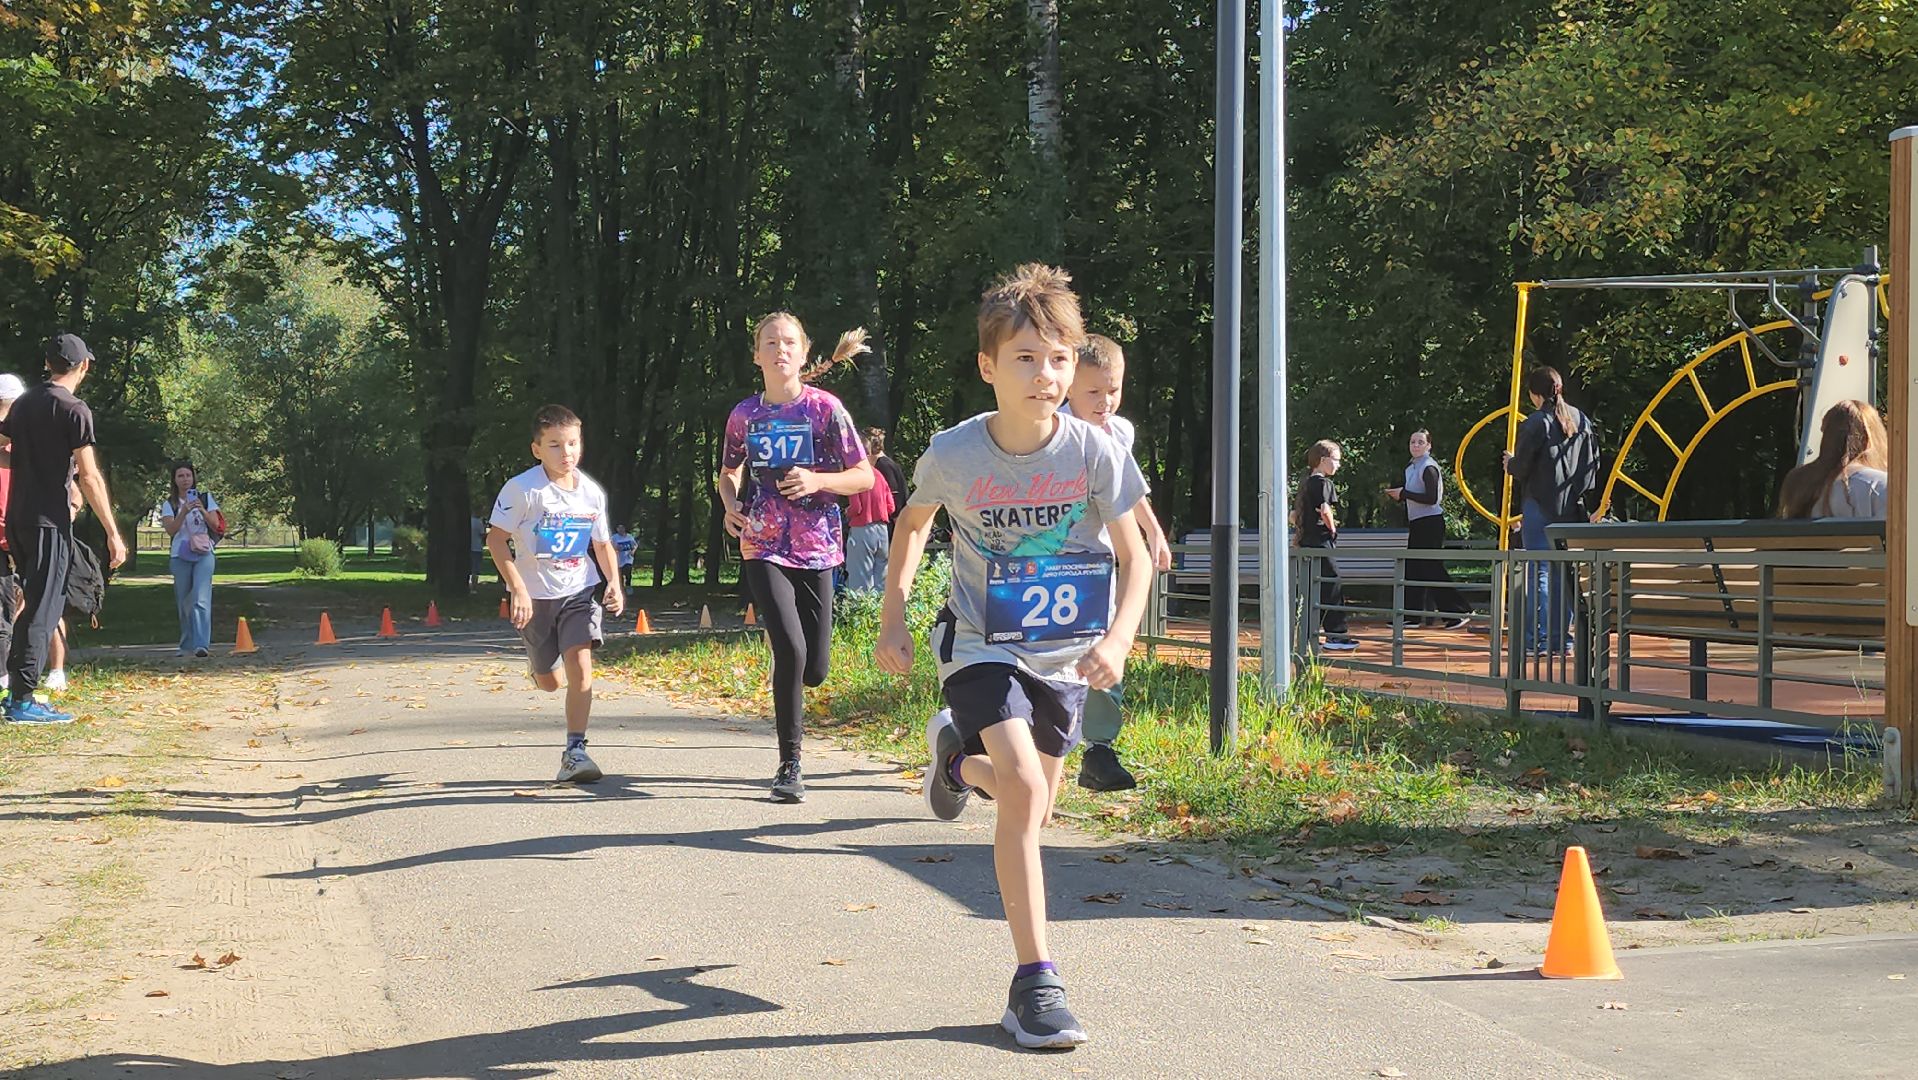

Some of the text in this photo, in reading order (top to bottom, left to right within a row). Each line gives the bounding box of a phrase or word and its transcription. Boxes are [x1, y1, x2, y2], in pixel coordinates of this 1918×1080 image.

[758, 436, 803, 460] 317
[964, 468, 1087, 505] New York
[551, 531, 579, 553] 37
[1022, 585, 1079, 627] 28
